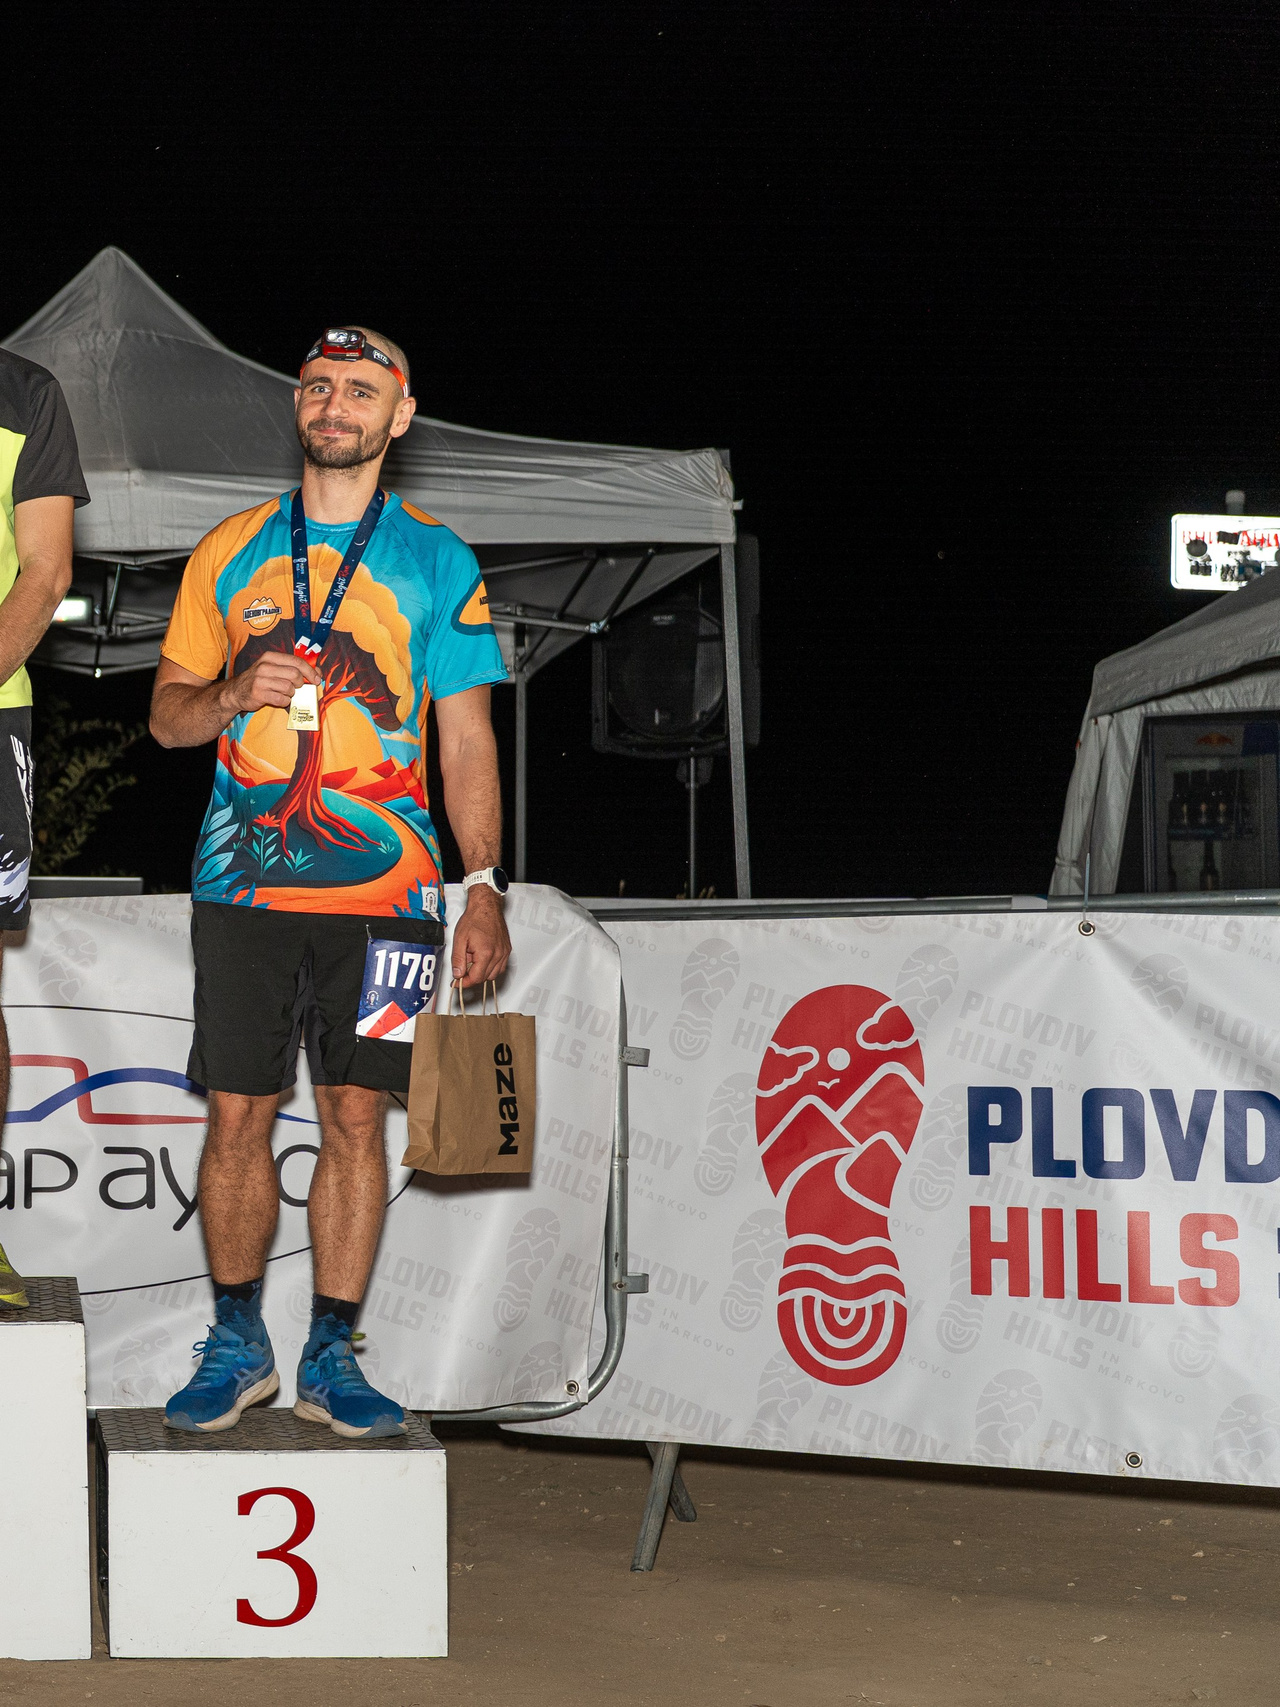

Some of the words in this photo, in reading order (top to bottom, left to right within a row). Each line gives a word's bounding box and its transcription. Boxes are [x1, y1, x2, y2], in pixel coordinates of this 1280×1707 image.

[789, 928, 870, 959] MARKOVO
[374, 949, 436, 992] 1178
[959, 990, 1097, 1057] PLOVDIV
[946, 1027, 1037, 1080] HILLS
[634, 1185, 707, 1221] MARKOVO
[969, 1205, 1241, 1308] HILLS
[659, 1320, 735, 1357] MARKOVO
[1003, 1311, 1094, 1370] HILLS
[612, 1371, 732, 1442] PLOVDIV
[1098, 1365, 1185, 1404] MARKOVO
[234, 1486, 319, 1626] 3
